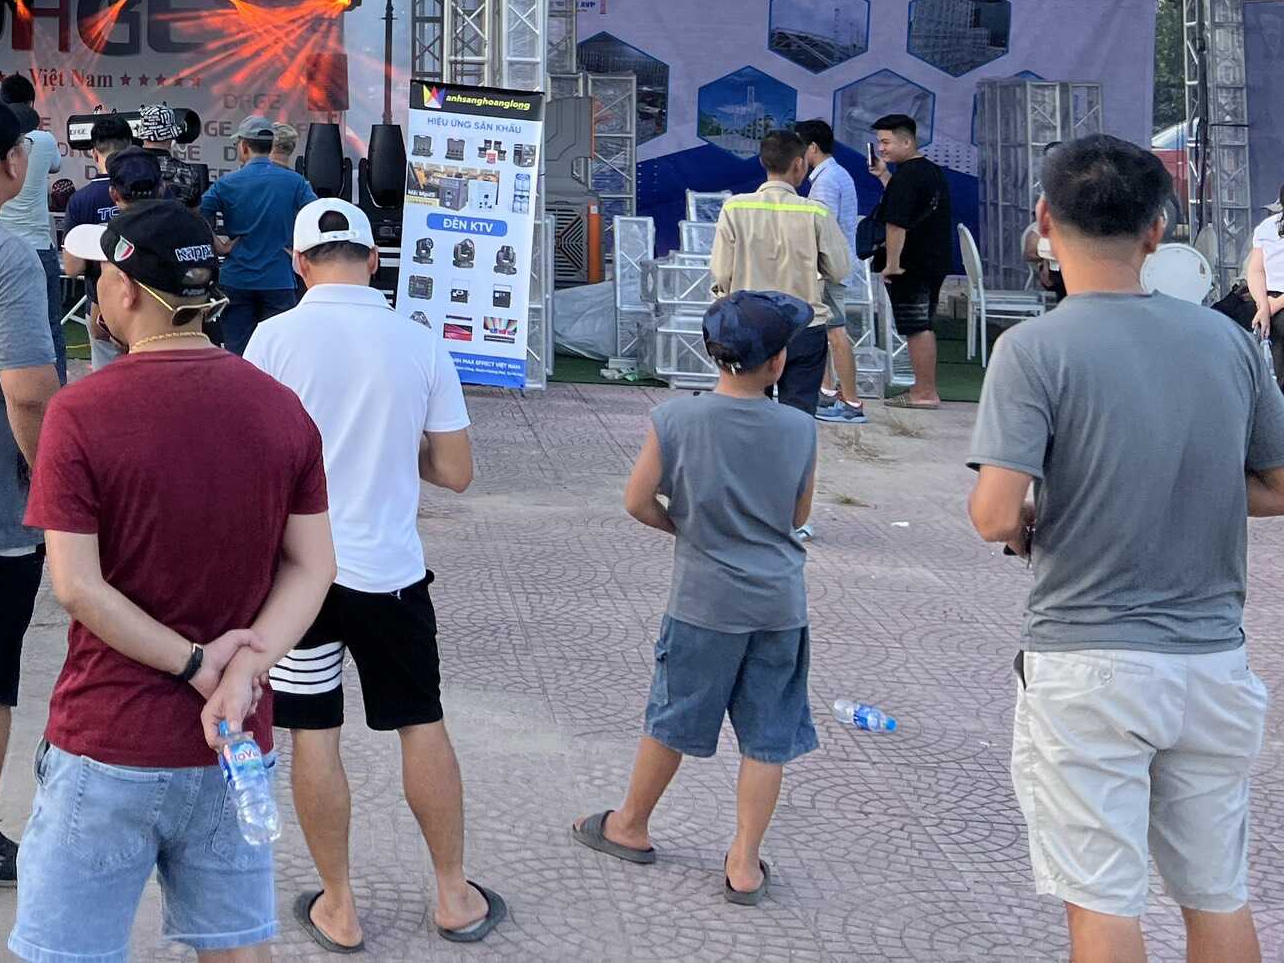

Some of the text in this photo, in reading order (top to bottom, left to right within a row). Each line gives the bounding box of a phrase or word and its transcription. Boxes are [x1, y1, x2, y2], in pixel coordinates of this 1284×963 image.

[28, 67, 113, 92] Việt Nam
[445, 94, 531, 111] anhsanghoanglong
[443, 216, 494, 233] ĐÈN KTV
